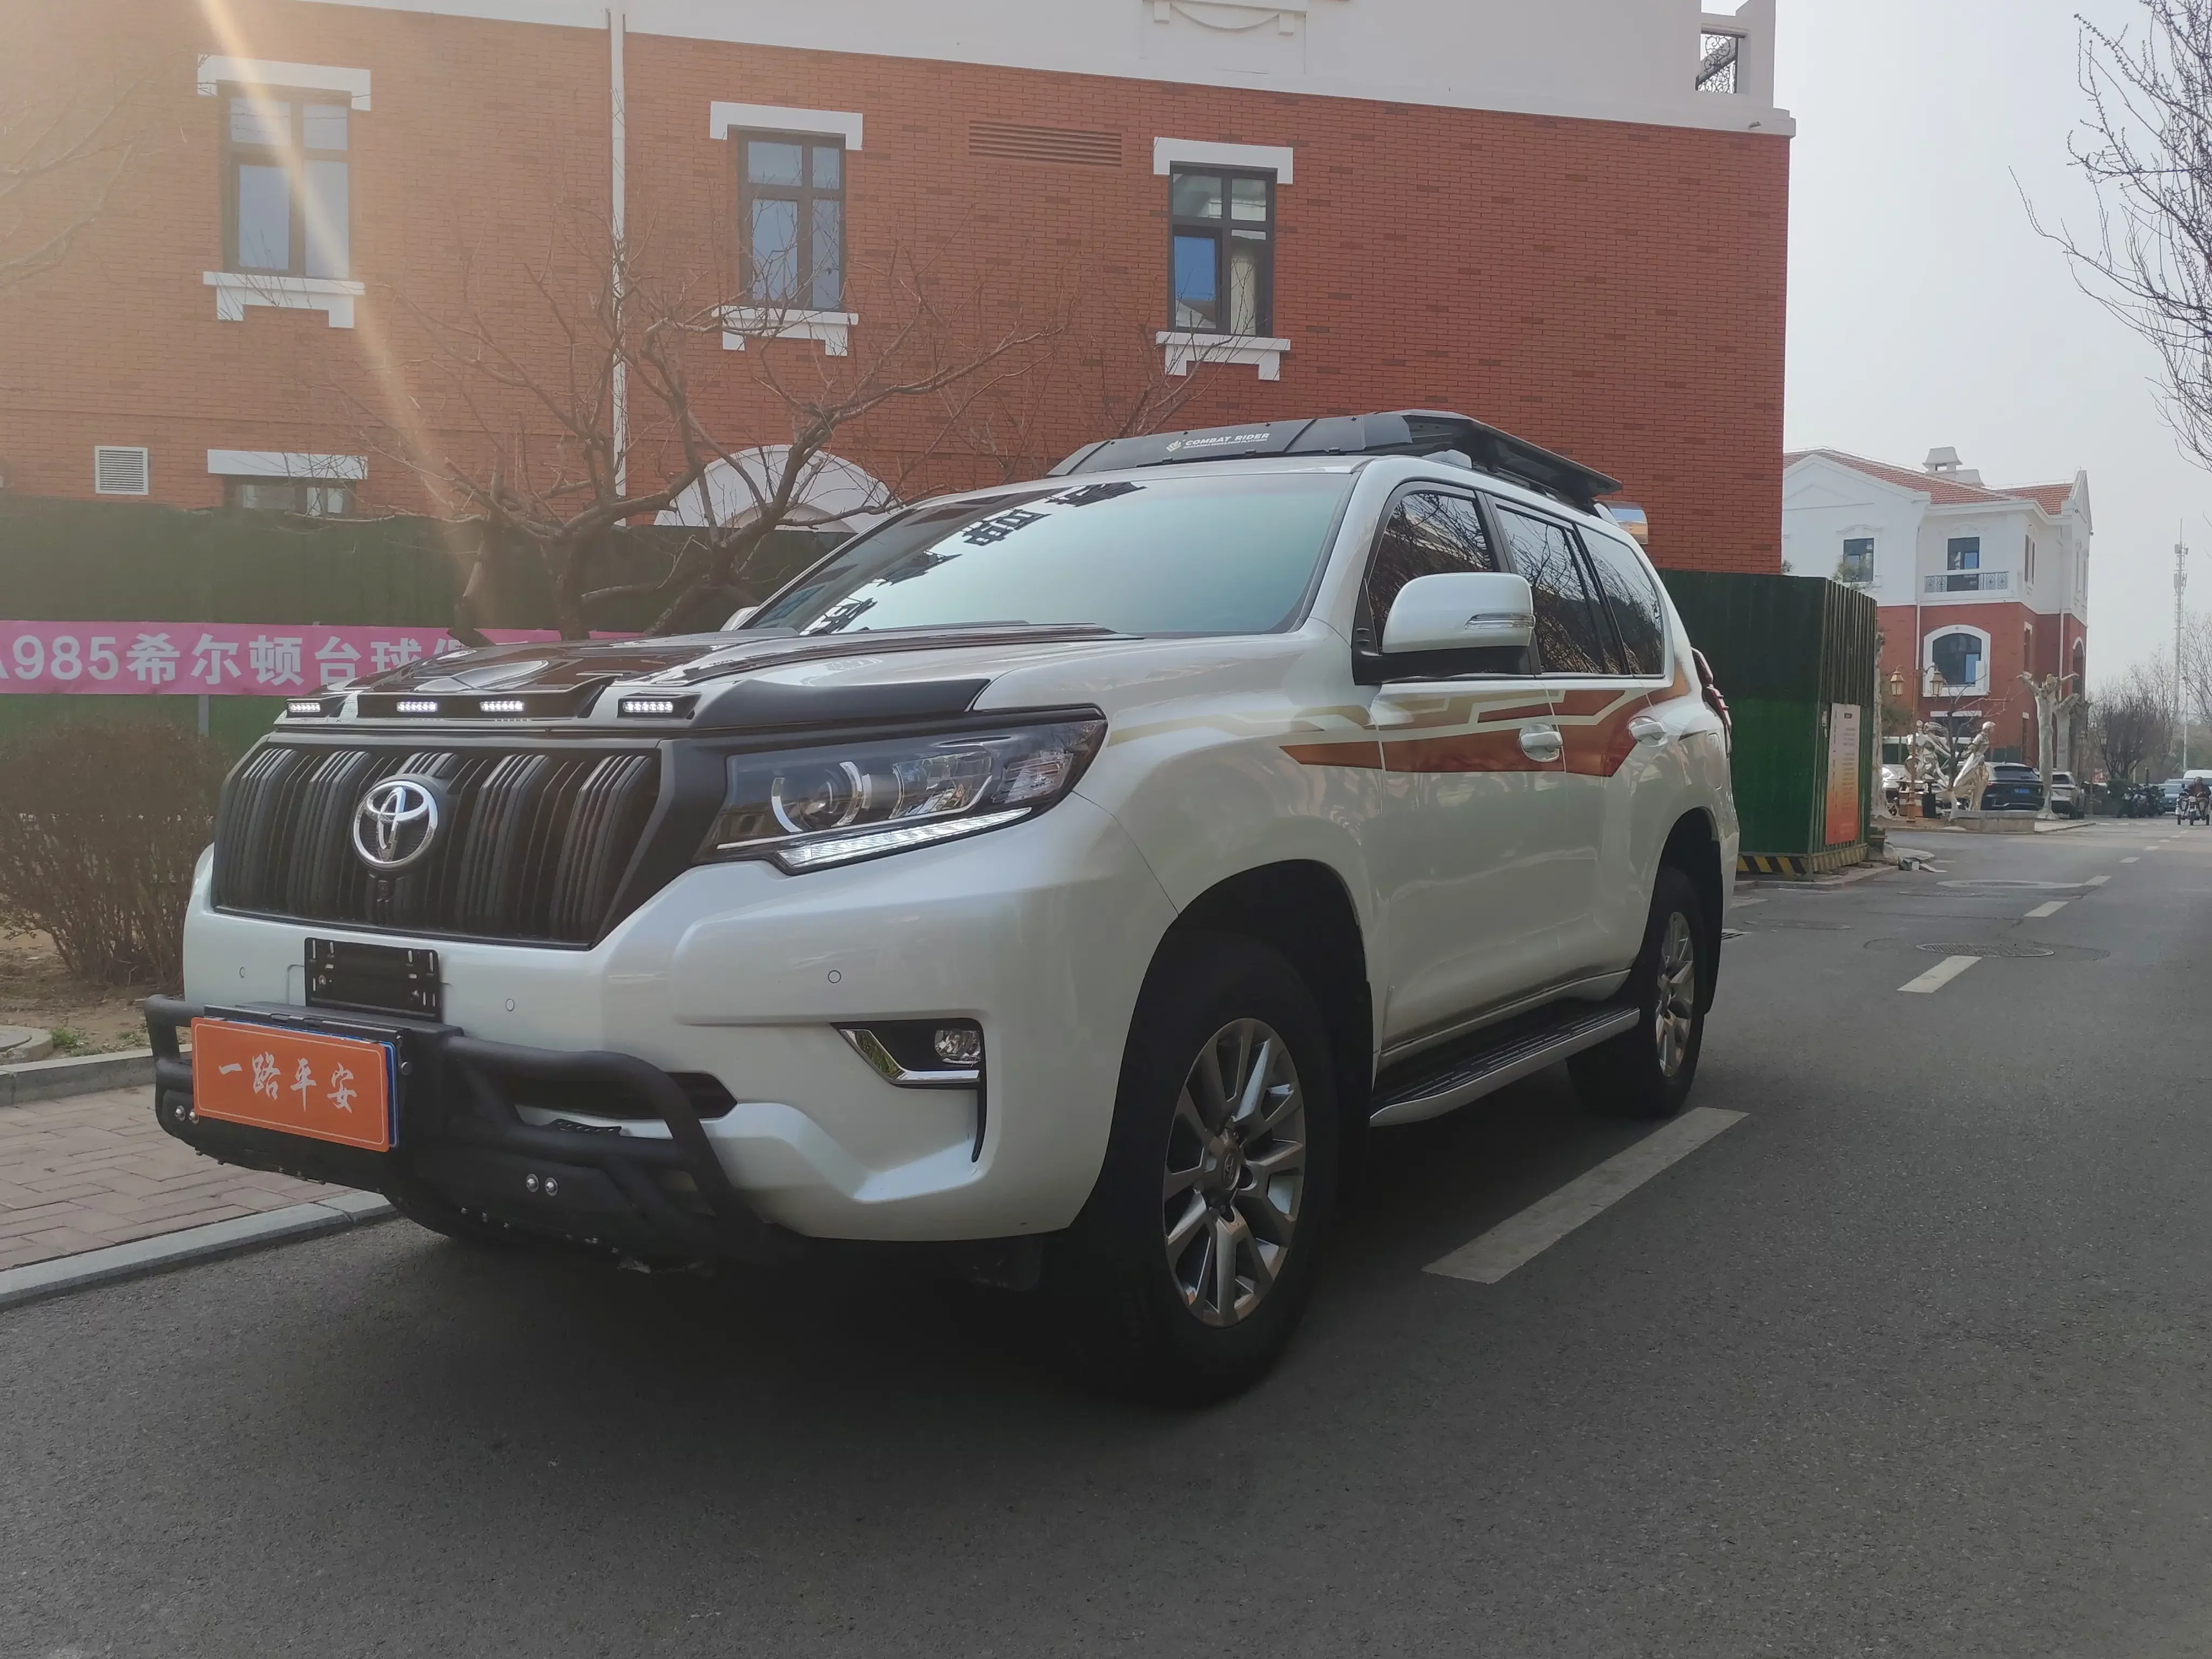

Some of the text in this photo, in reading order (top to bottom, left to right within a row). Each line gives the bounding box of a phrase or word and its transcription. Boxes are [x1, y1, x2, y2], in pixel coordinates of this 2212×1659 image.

[1185, 436, 1232, 446] COMBAT
[1234, 433, 1270, 441] RIDER
[219, 1051, 358, 1113] 一路平安
